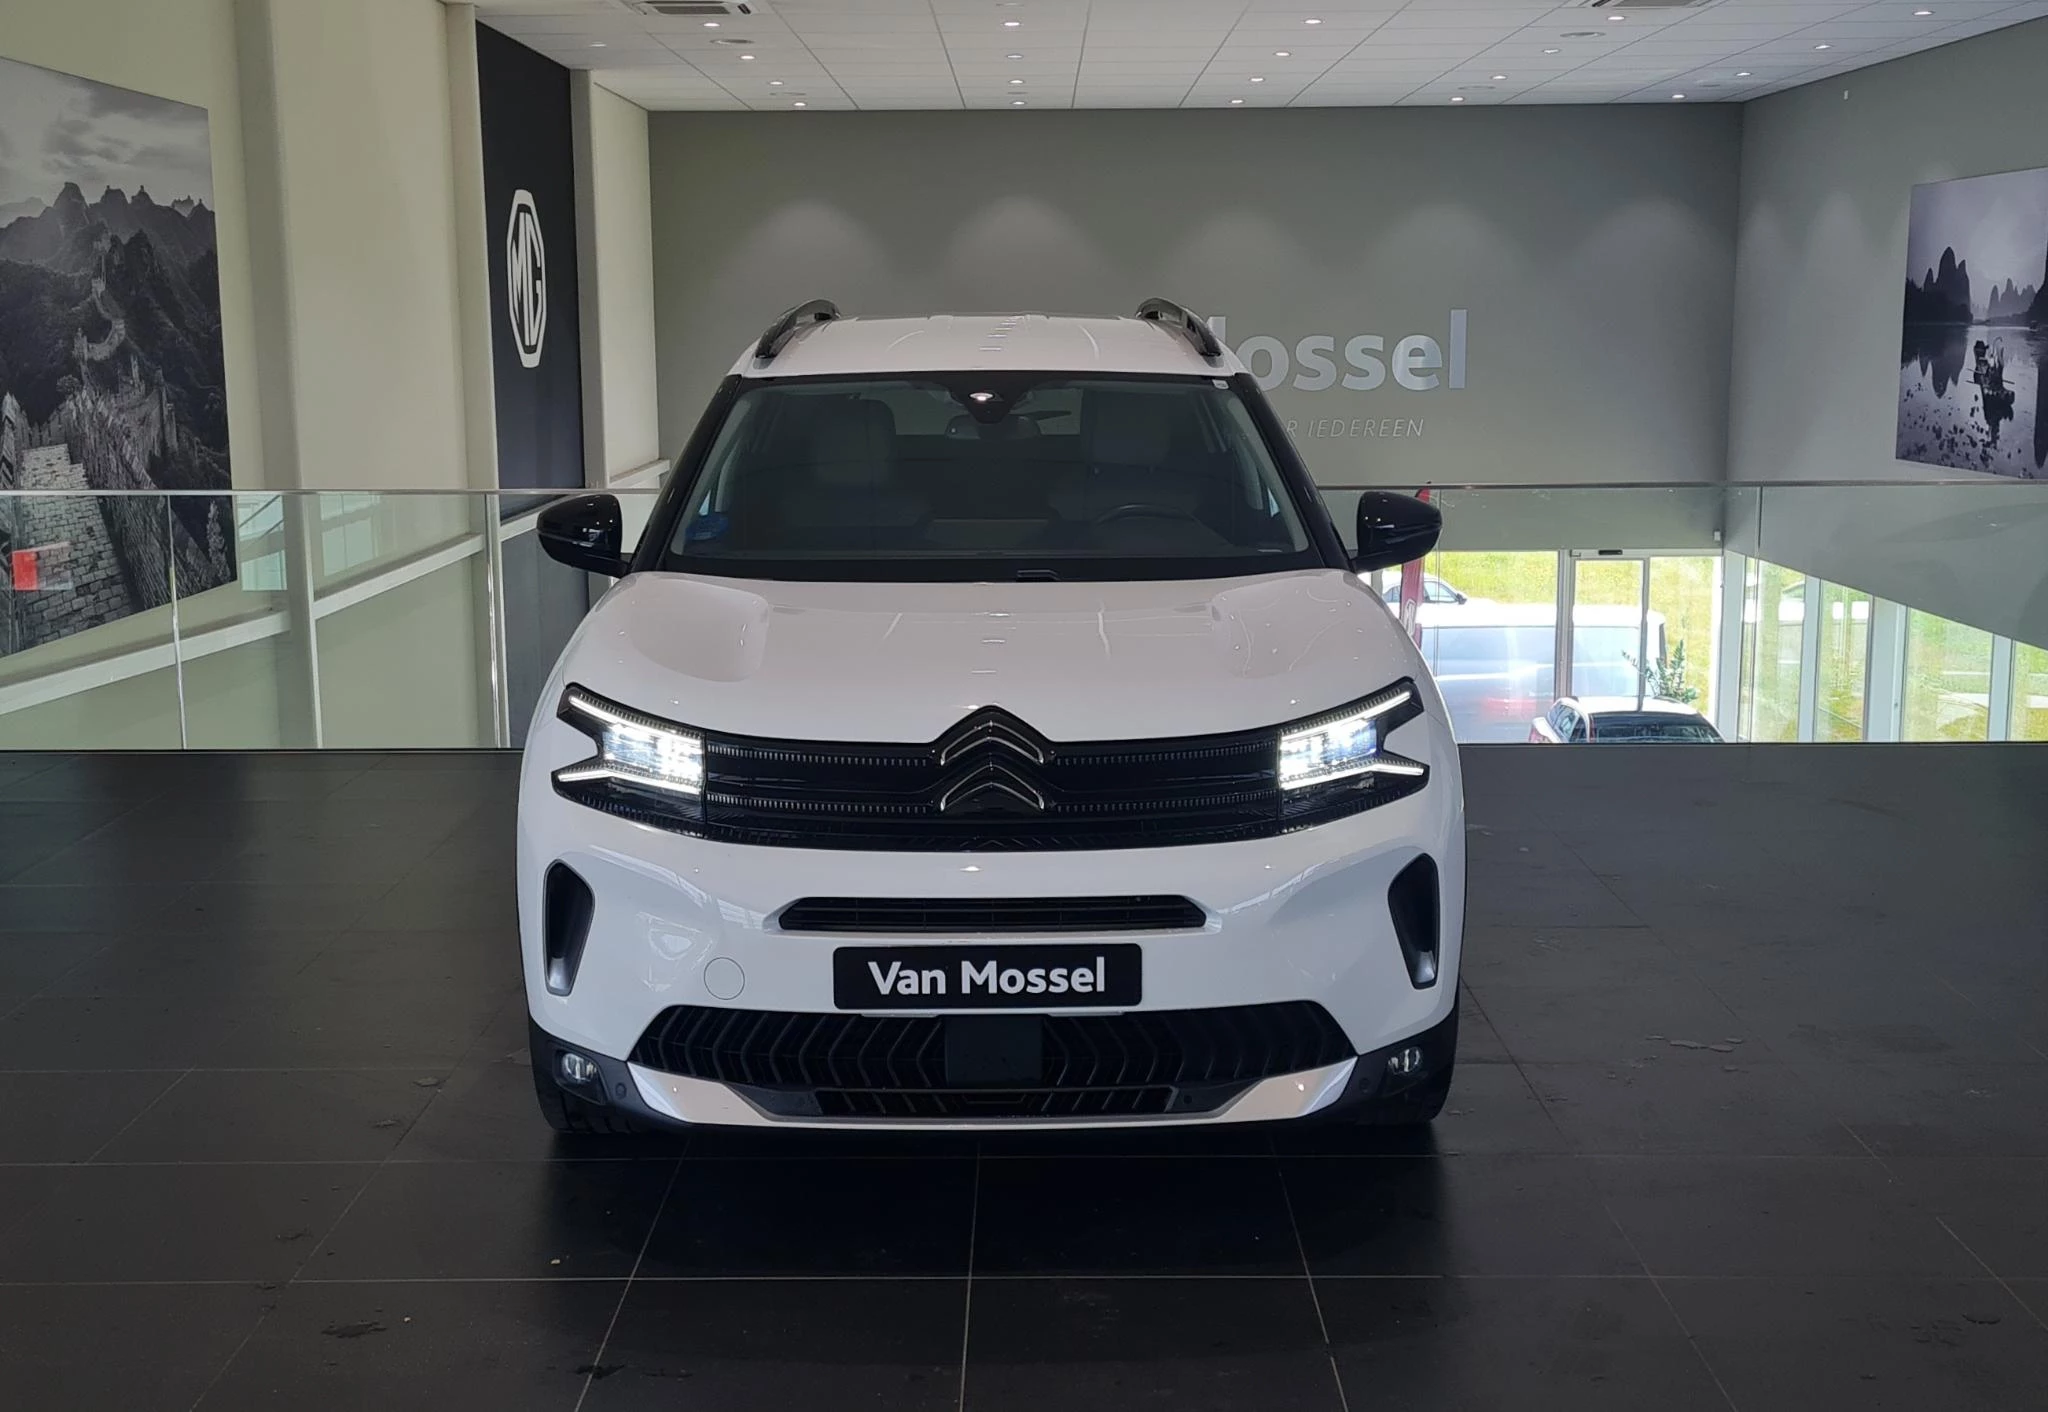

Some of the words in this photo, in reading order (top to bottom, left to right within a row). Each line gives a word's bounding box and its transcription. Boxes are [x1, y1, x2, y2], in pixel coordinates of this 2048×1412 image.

[510, 211, 543, 347] MG
[1308, 418, 1424, 438] IEDEREEN
[868, 961, 946, 995] Van
[961, 956, 1105, 994] Mossel
